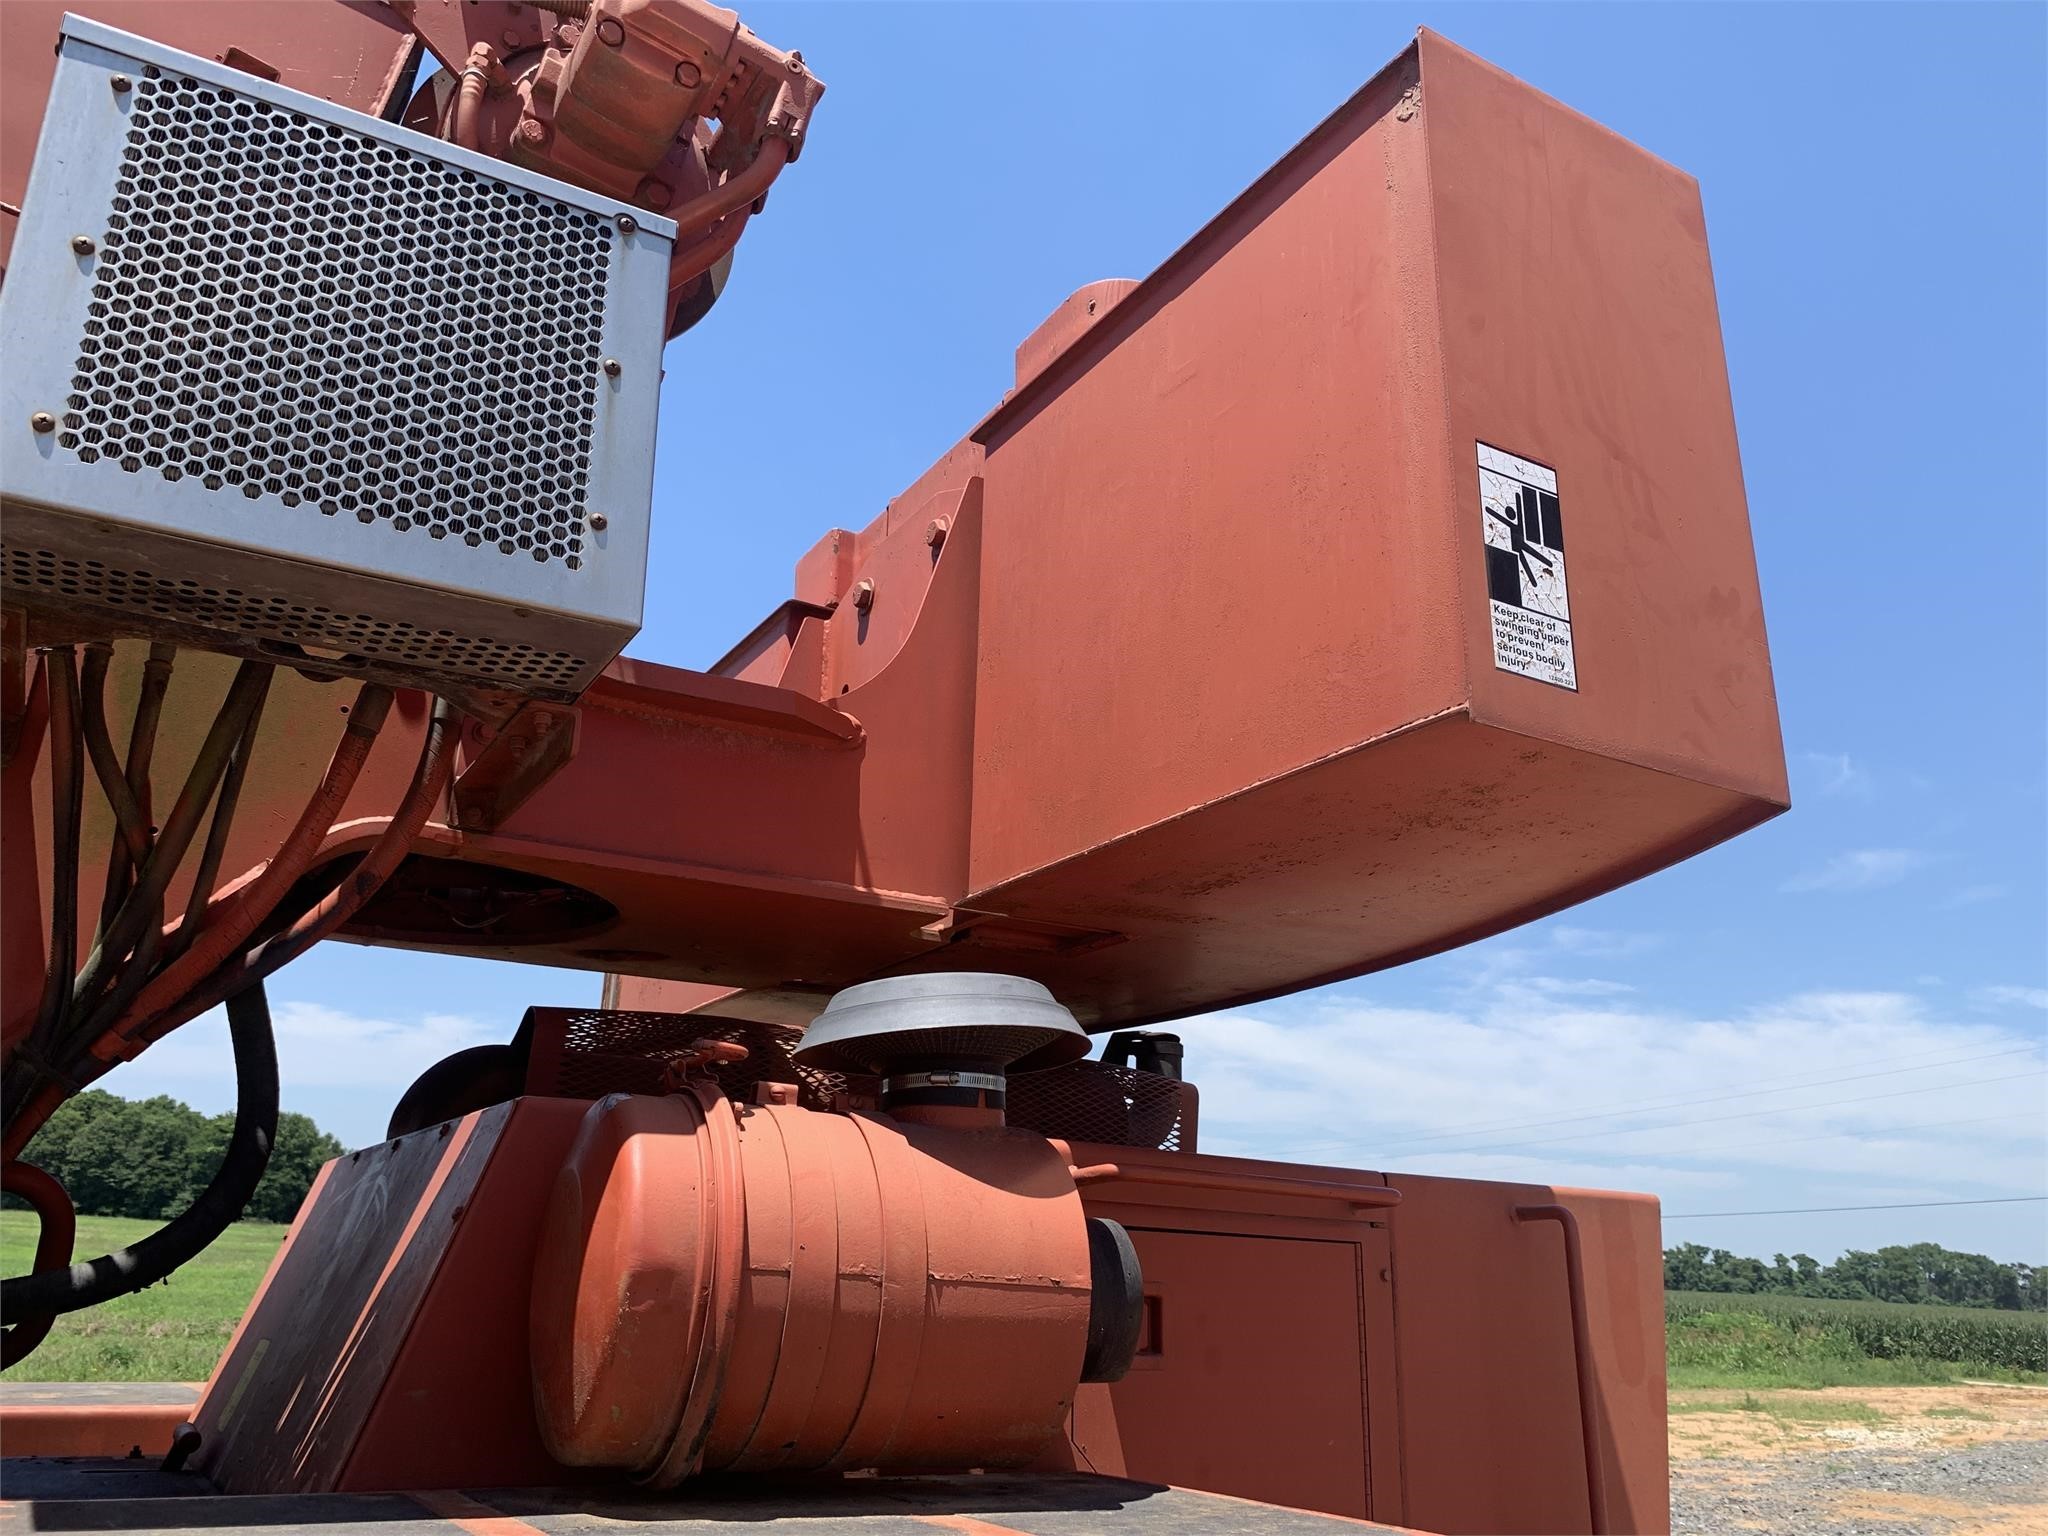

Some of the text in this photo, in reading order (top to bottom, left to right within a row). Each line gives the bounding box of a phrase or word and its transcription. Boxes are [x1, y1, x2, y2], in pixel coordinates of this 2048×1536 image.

[1493, 604, 1556, 631] Keep clear of
[1495, 617, 1569, 646] swinging upper
[1496, 629, 1545, 651] to prevent
[1497, 642, 1566, 670] serious bodily
[1498, 653, 1528, 670] injury.
